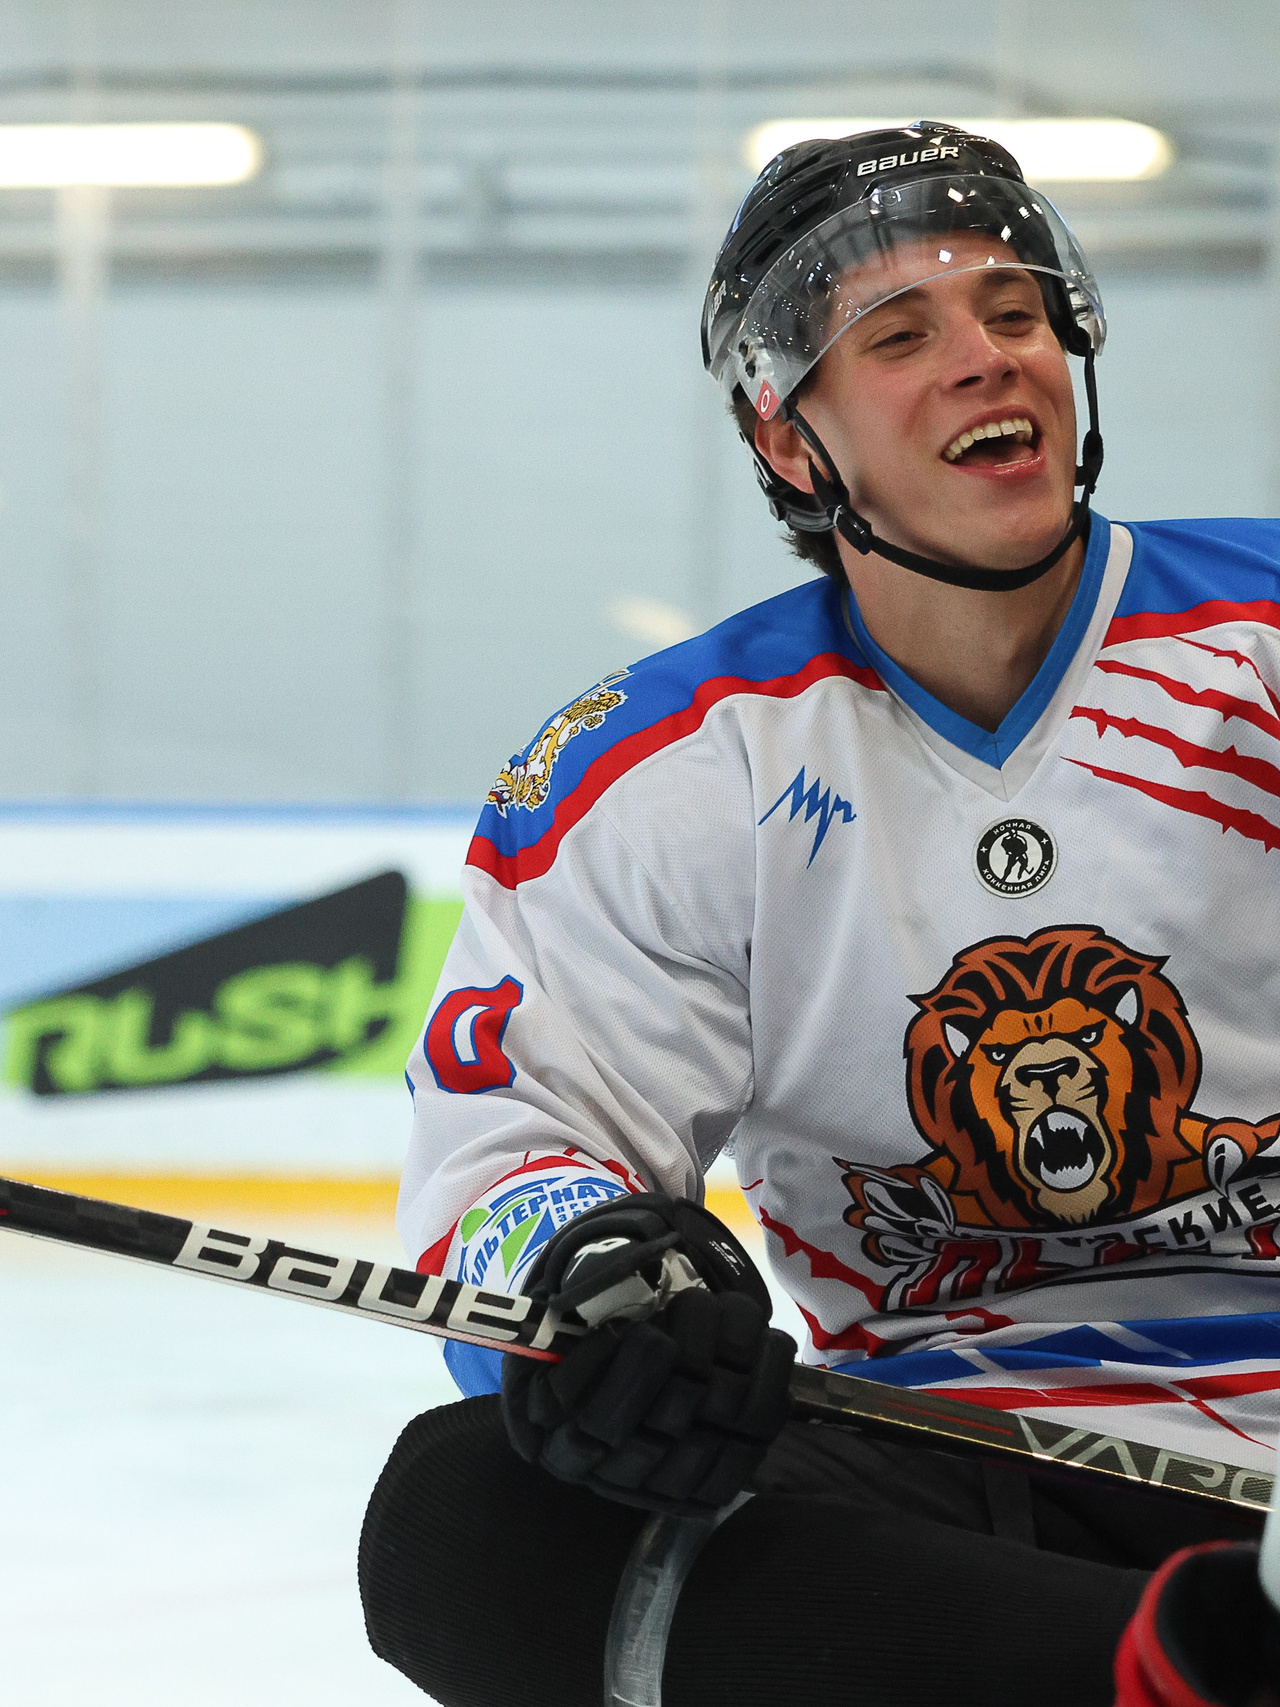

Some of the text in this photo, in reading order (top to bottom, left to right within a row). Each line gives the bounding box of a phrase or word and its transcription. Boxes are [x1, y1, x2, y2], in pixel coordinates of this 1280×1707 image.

[992, 822, 1032, 836] НОЧНАЯ
[982, 859, 1051, 892] ХОККЕЙНАЯ ЛИГА
